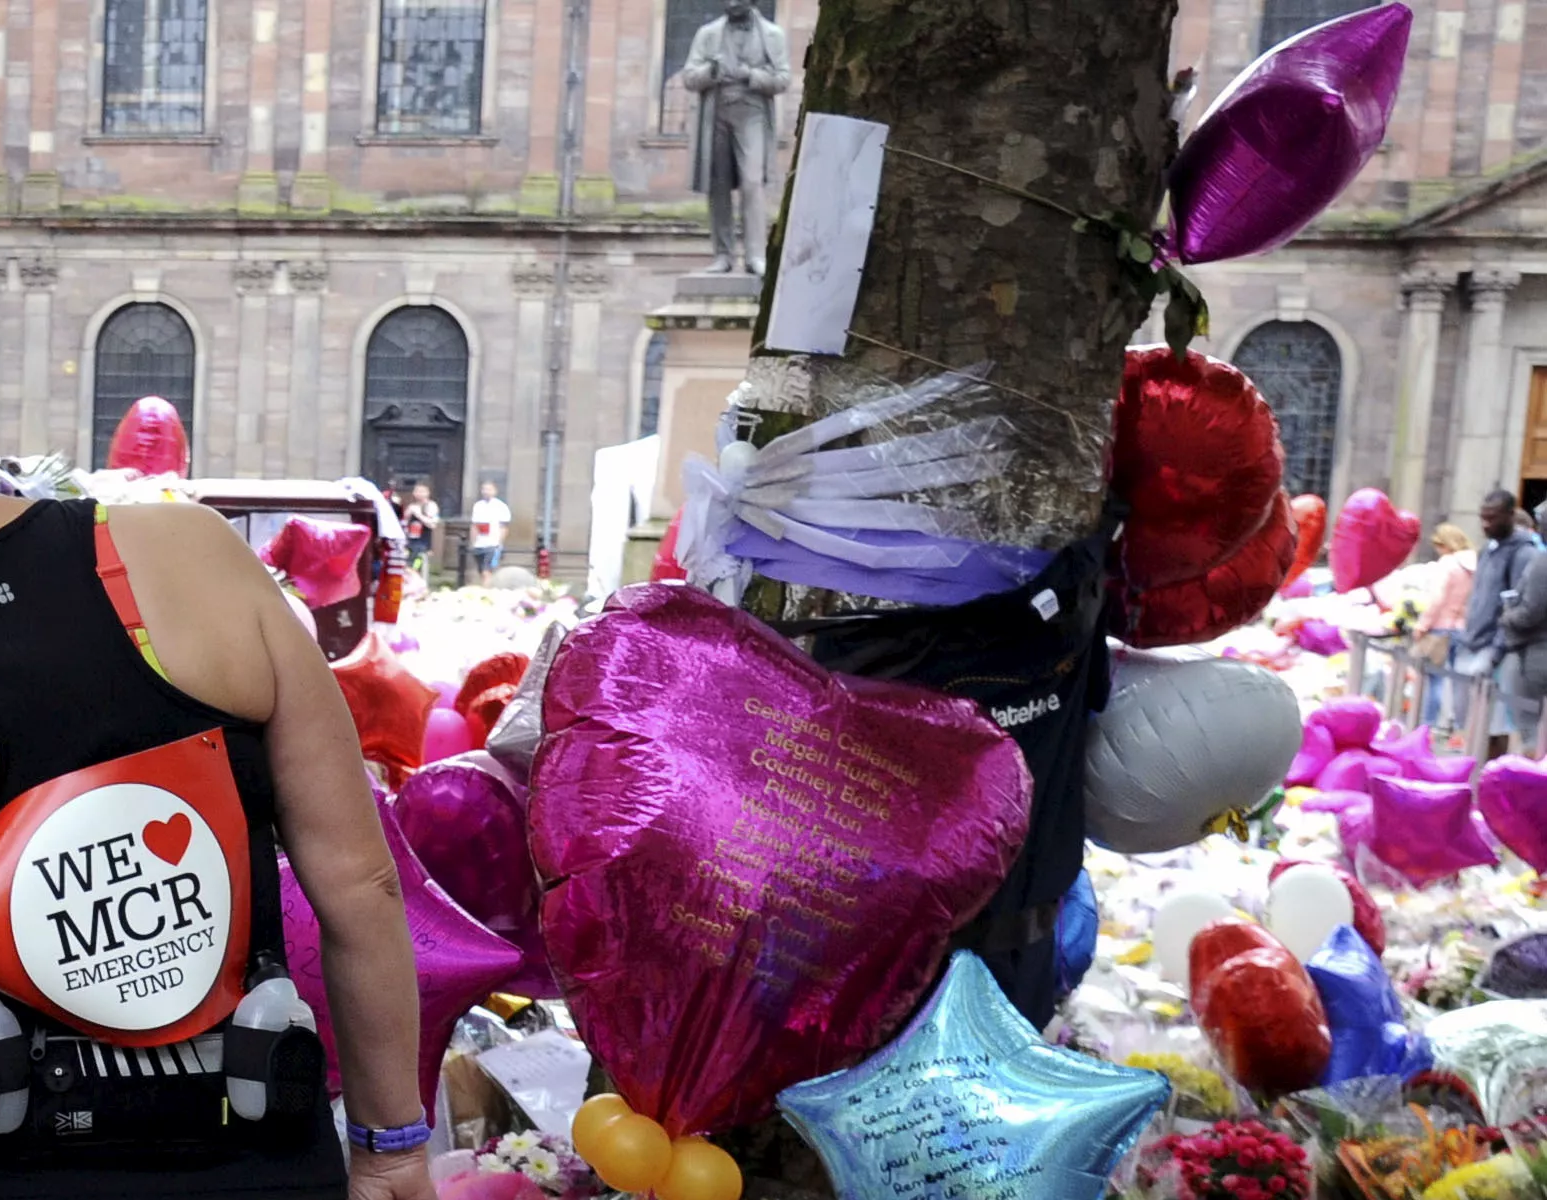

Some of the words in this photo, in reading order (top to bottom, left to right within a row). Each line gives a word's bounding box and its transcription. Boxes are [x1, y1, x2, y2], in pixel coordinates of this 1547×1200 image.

[743, 697, 832, 743] Georgina
[750, 748, 837, 799] Courtney
[839, 785, 890, 822] Boyle
[764, 727, 830, 767] Megan
[834, 757, 893, 799] Hurley
[823, 801, 863, 834] Tron
[32, 832, 143, 902] WE
[46, 872, 213, 966] MCR
[62, 926, 216, 992] EMERGENCY
[116, 965, 185, 1004] FUND
